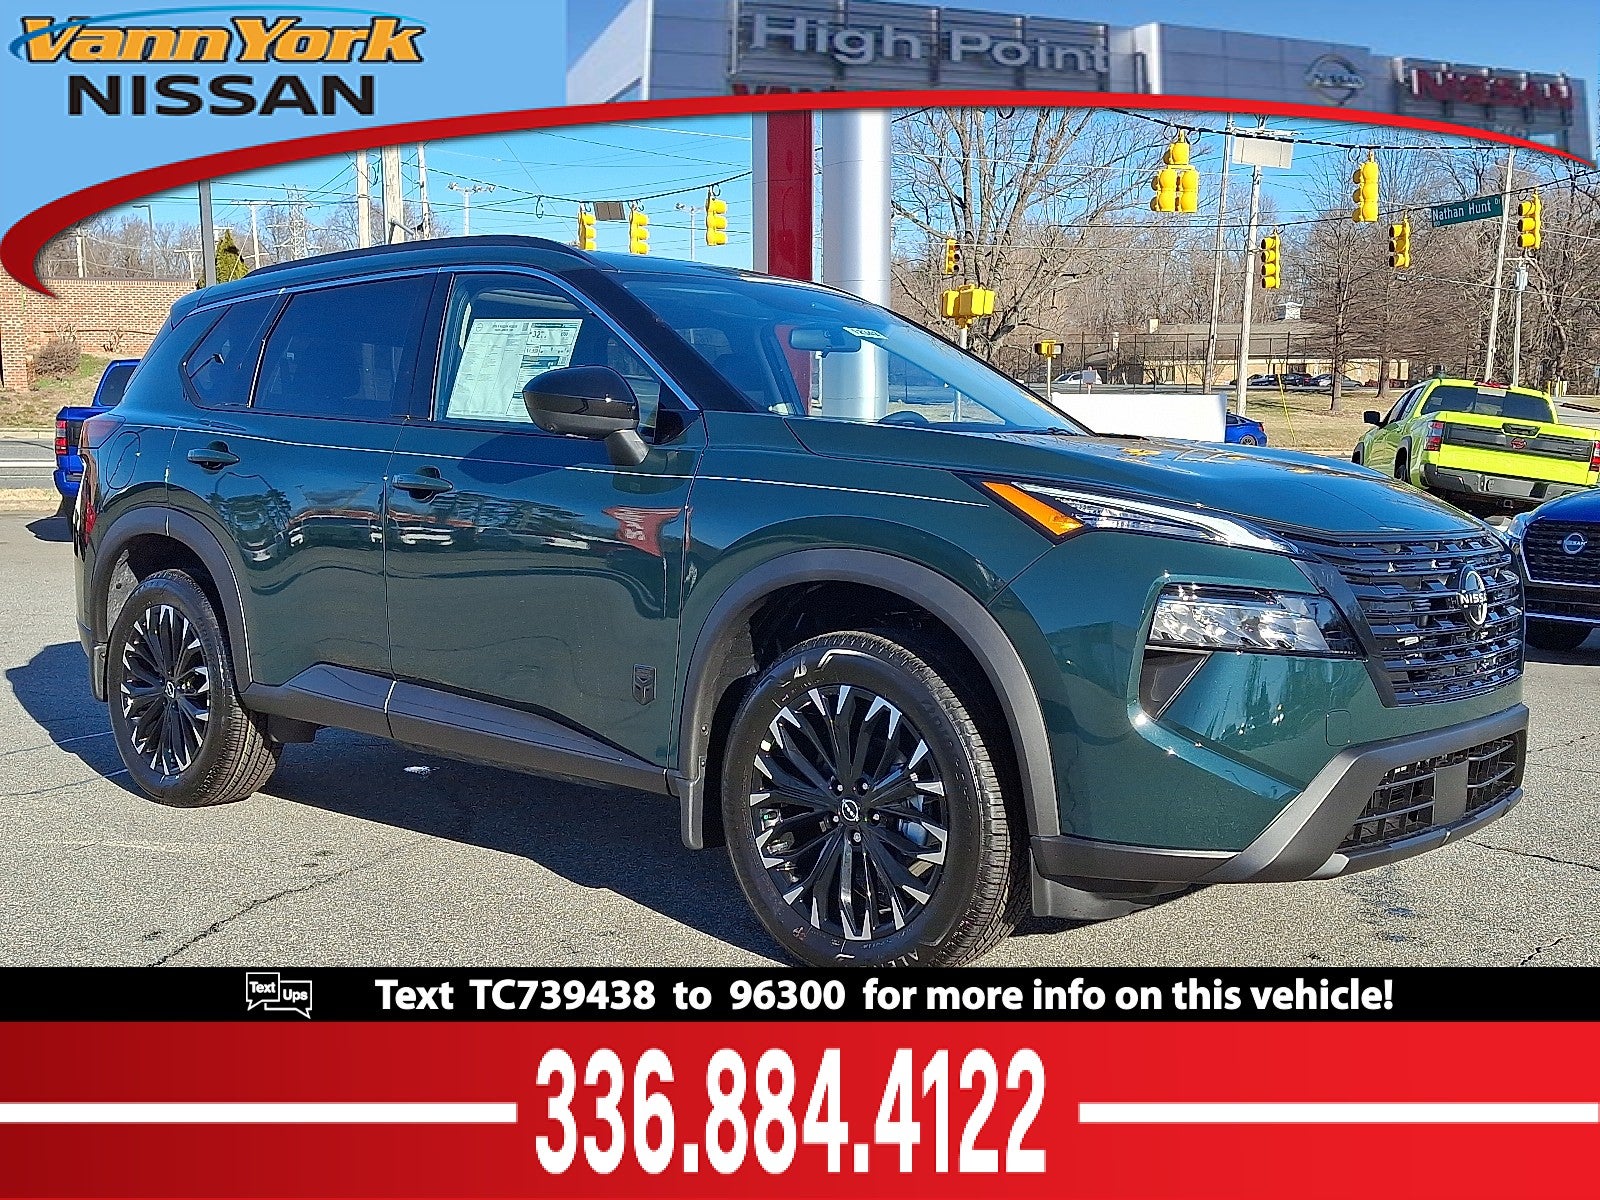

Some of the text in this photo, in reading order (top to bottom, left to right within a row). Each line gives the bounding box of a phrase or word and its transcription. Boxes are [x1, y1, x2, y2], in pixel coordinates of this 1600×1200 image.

[751, 14, 1109, 73] High Point
[1432, 207, 1464, 221] Nathan
[1468, 200, 1491, 215] Hunt
